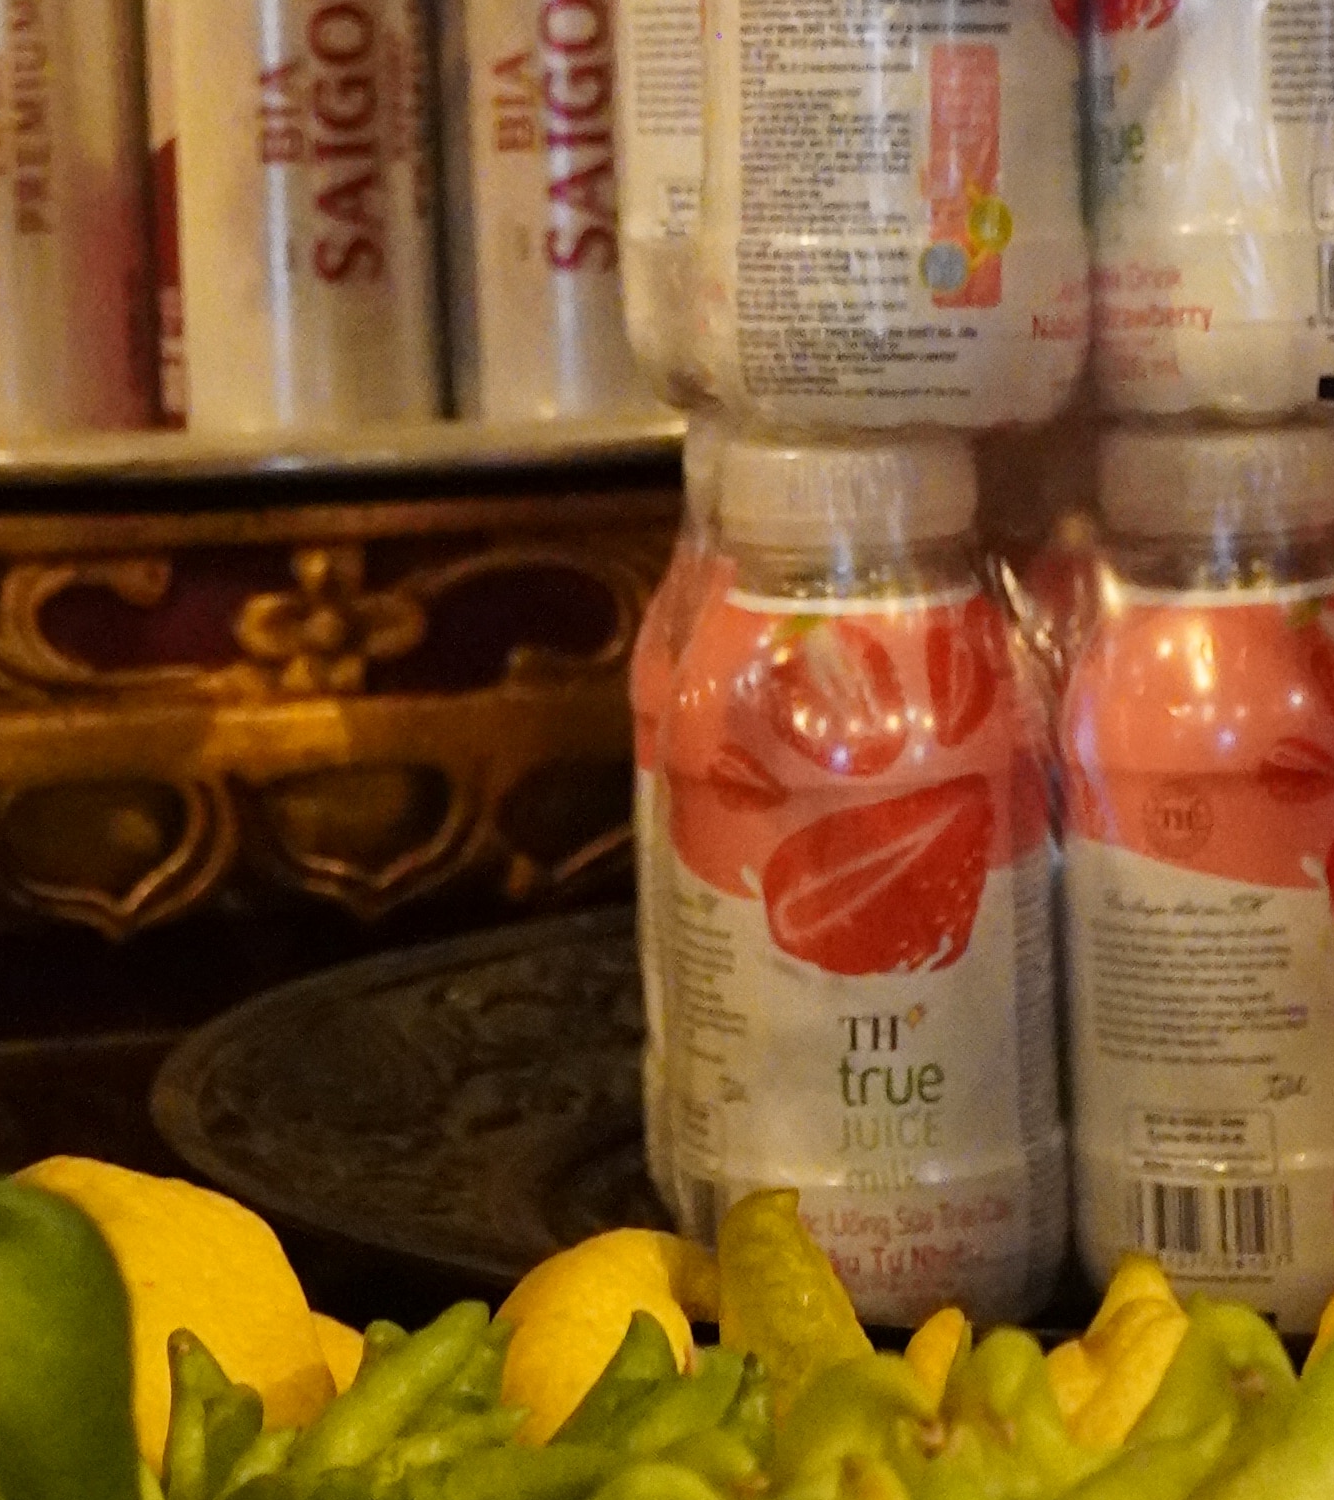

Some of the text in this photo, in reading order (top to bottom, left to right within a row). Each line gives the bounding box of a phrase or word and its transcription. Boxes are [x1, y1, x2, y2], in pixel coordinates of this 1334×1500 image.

[256, 62, 304, 165] BIA
[493, 52, 538, 153] BIA
[837, 1013, 901, 1053] TH
[837, 1055, 946, 1108] true
